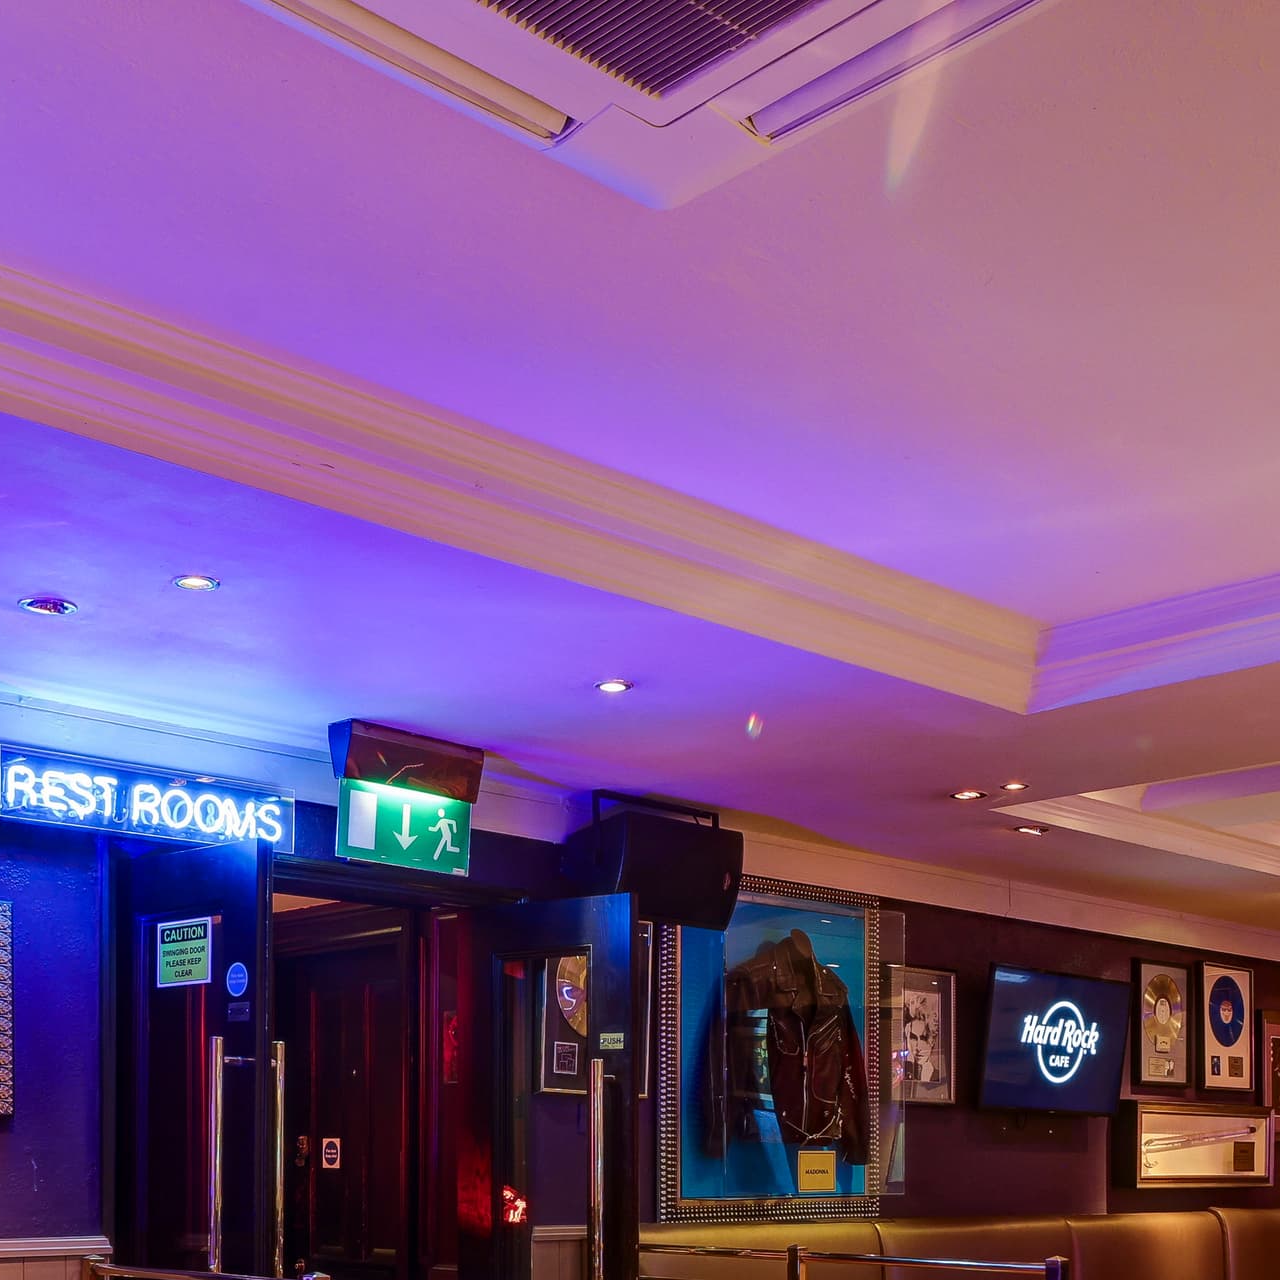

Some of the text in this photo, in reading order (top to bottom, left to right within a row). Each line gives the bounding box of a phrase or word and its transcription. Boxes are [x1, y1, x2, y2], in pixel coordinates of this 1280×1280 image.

[6, 765, 282, 842] REST ROOMS
[164, 925, 204, 942] CAUTION
[162, 945, 206, 958] SWINGING DOOR
[165, 957, 202, 968] PLEASE KEEP
[174, 969, 193, 978] CLEAR
[601, 1037, 622, 1045] PUSH
[1020, 1014, 1099, 1055] Hard Rock
[1048, 1054, 1070, 1068] CAFE
